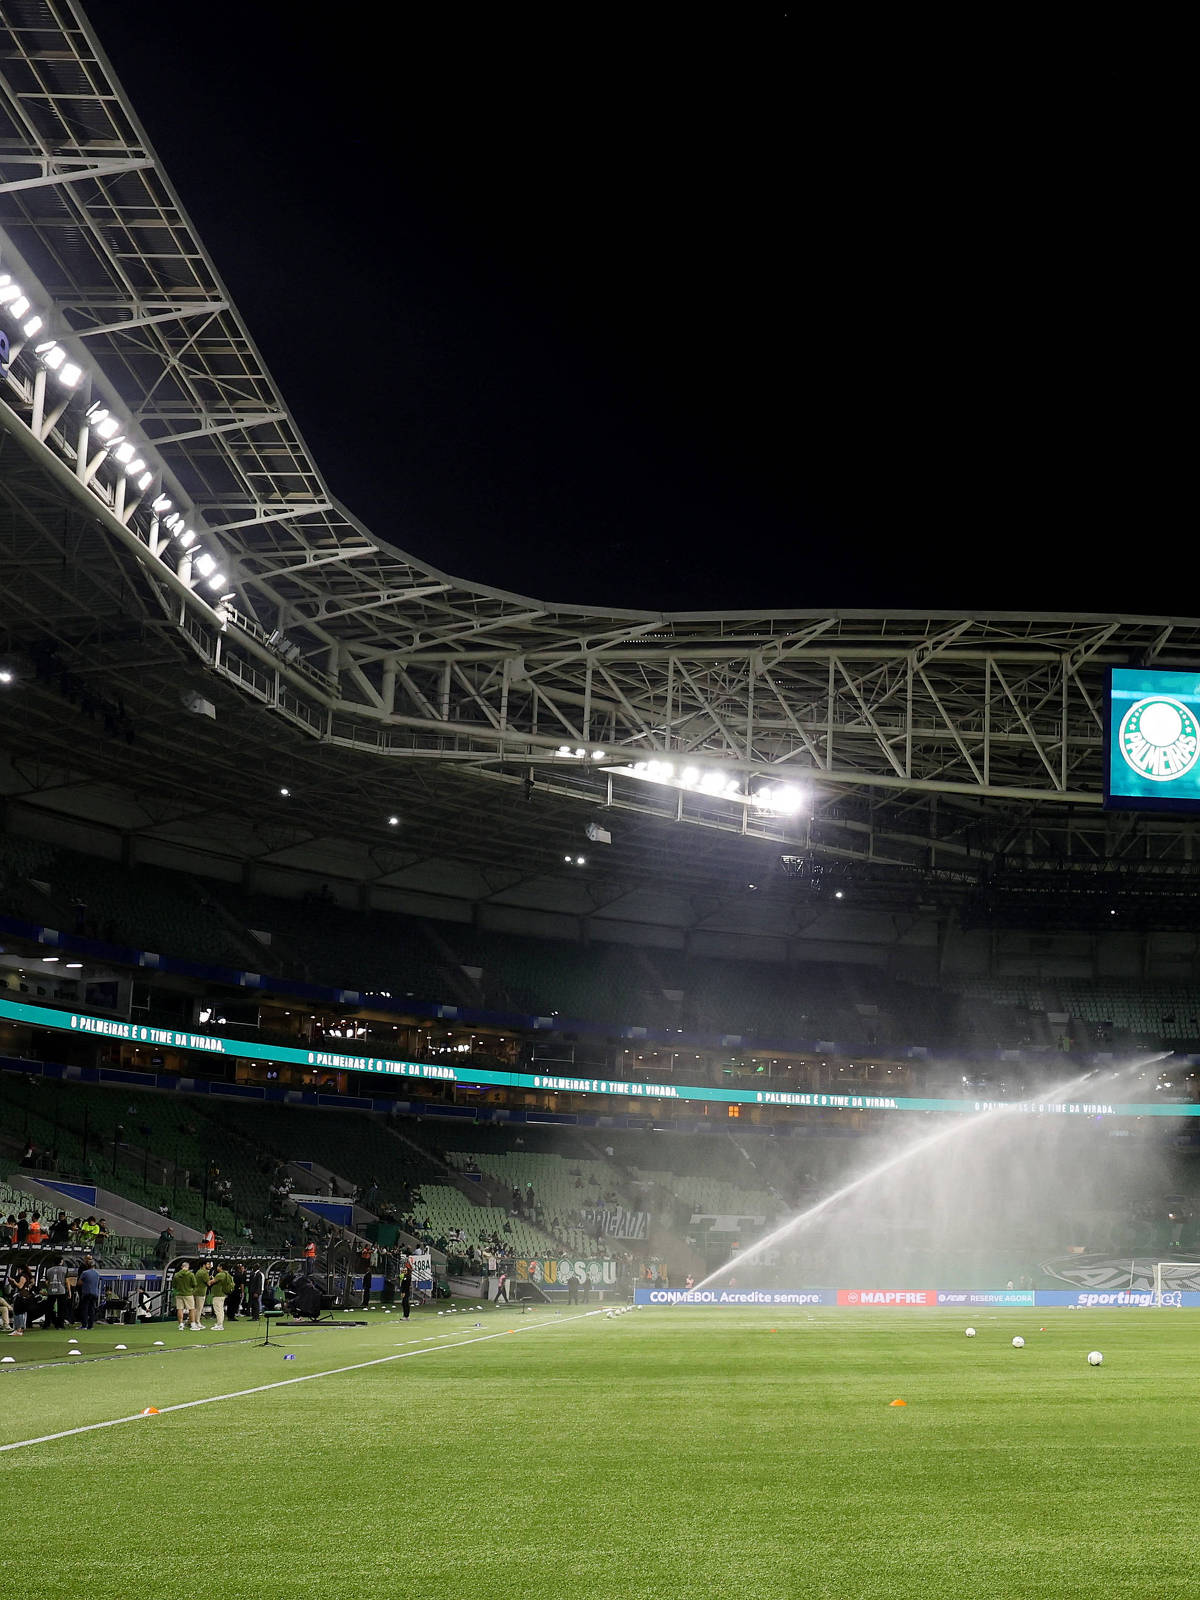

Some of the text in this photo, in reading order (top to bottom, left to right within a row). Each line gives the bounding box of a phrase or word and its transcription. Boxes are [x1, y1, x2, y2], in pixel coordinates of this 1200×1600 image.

[1124, 731, 1197, 776] PALMEIRAS
[70, 1015, 78, 1029] O
[79, 1017, 130, 1038] PALMEIRAS
[131, 1024, 138, 1039] É
[140, 1027, 148, 1041] O
[150, 1029, 173, 1044] TIME
[174, 1033, 187, 1047] DA
[307, 1052, 315, 1064] O
[316, 1053, 366, 1070] PALMEIRAS
[367, 1057, 374, 1071] É
[375, 1060, 383, 1072] O
[385, 1061, 407, 1074] TIME
[408, 1064, 421, 1076] DA
[533, 1076, 541, 1088] O
[542, 1077, 591, 1092] PALMEIRAS
[592, 1079, 599, 1092] É
[600, 1081, 608, 1093] O
[608, 1082, 630, 1095] TIME
[631, 1084, 644, 1096] DA
[756, 1092, 764, 1103] O
[765, 1092, 812, 1106] PALMEIRAS
[813, 1093, 820, 1106] É
[821, 1095, 828, 1106] O
[829, 1096, 850, 1107] TIME
[851, 1097, 863, 1108] DA
[649, 1291, 717, 1303] CONMEBOL
[719, 1290, 772, 1303] Acredite
[860, 1292, 927, 1304] MAPFRE
[970, 1294, 1004, 1302] RESERVE
[1004, 1294, 1033, 1303] AGORA
